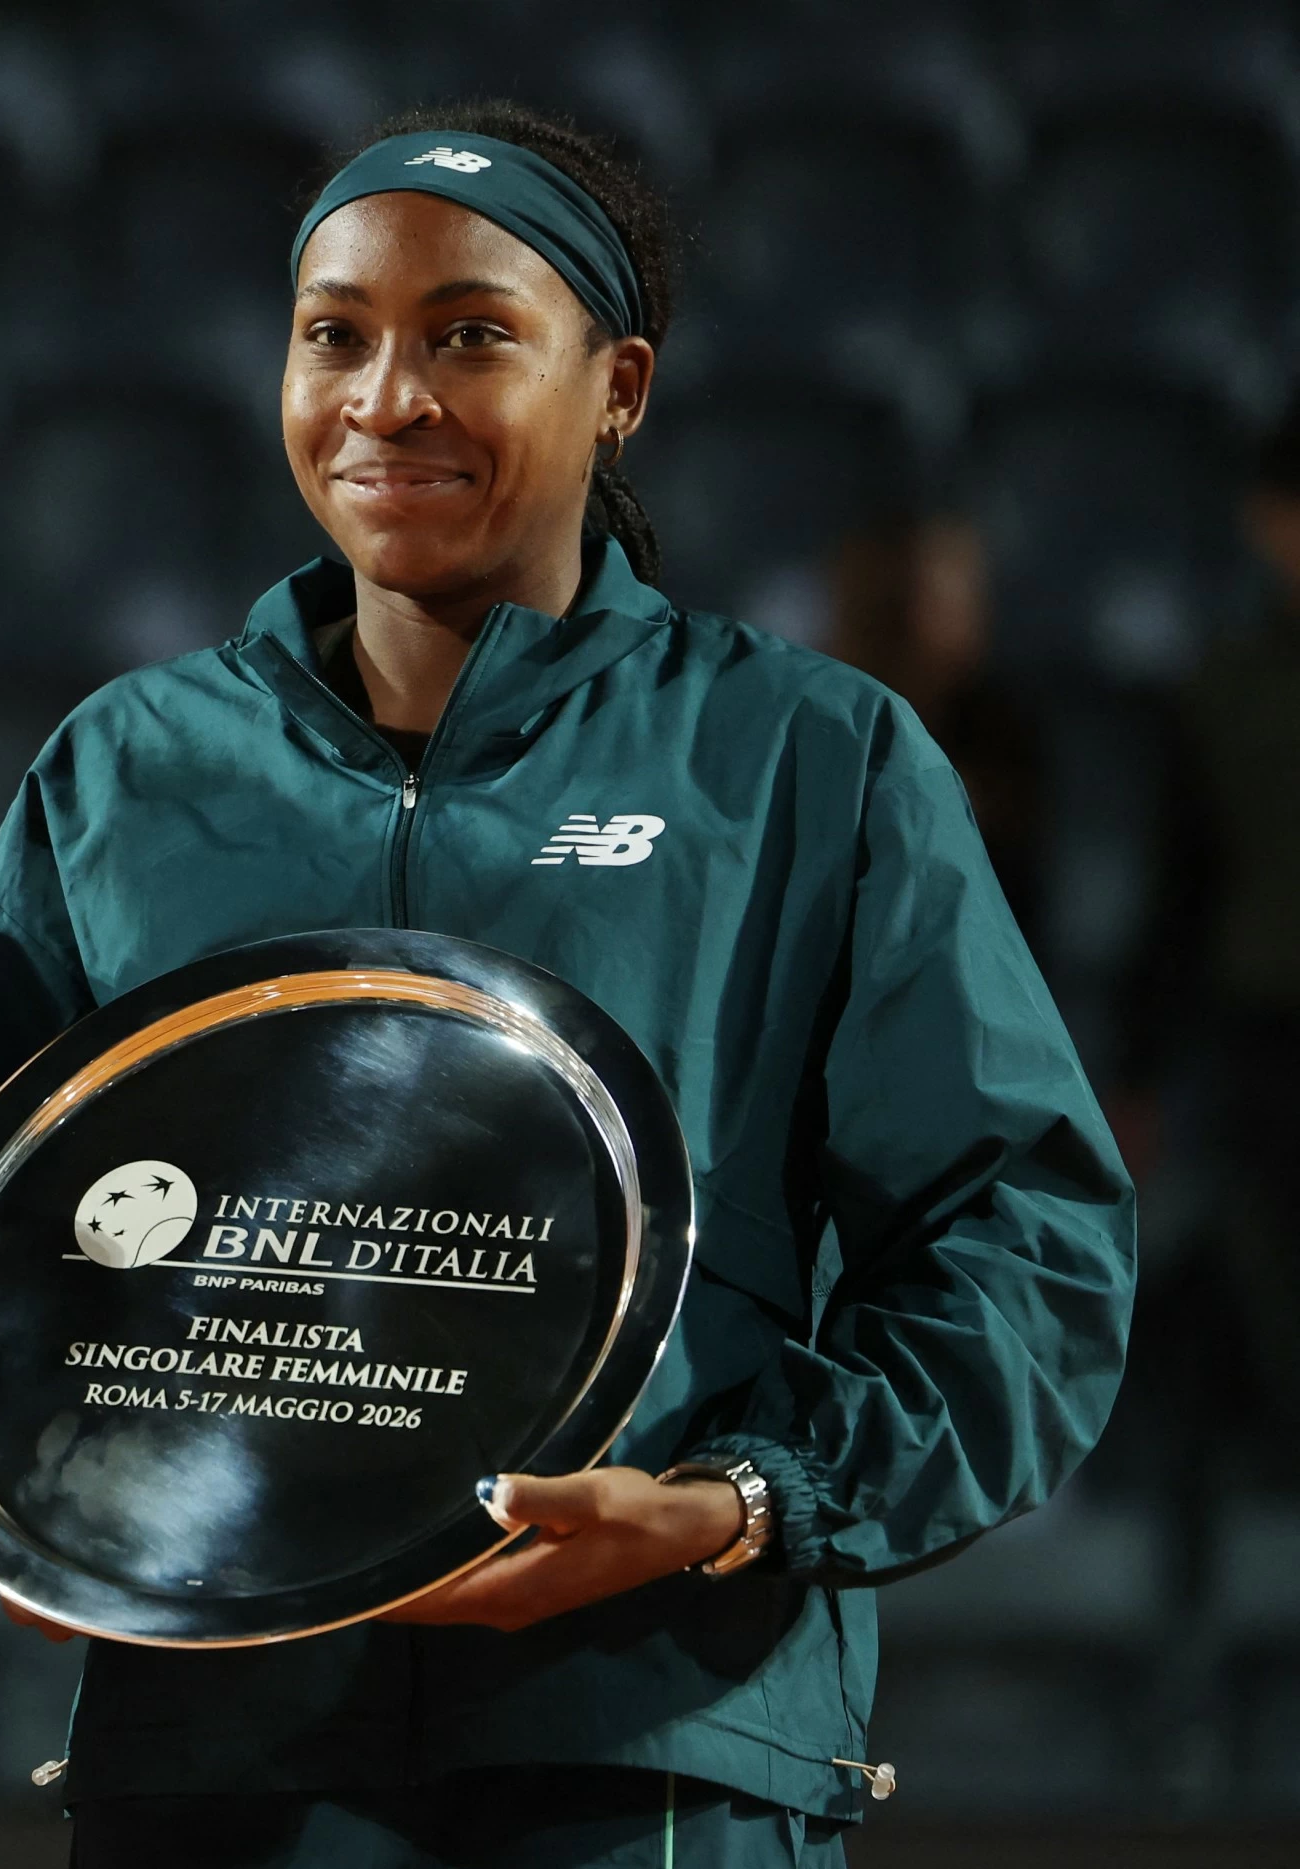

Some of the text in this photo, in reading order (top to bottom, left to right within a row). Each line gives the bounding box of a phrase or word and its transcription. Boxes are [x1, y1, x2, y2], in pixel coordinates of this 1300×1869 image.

[404, 147, 491, 173] NB
[531, 815, 665, 866] NB
[215, 1195, 554, 1241] INTERNAZIONALI
[203, 1226, 536, 1282] BNL D'ITALIA
[194, 1275, 324, 1295] BNP PARIBAS
[187, 1316, 364, 1352] FINALISTA
[66, 1344, 467, 1394] SINGOLARE FEMMINILE
[84, 1384, 422, 1428] ROMA 5-17 MAGGIO 2026
